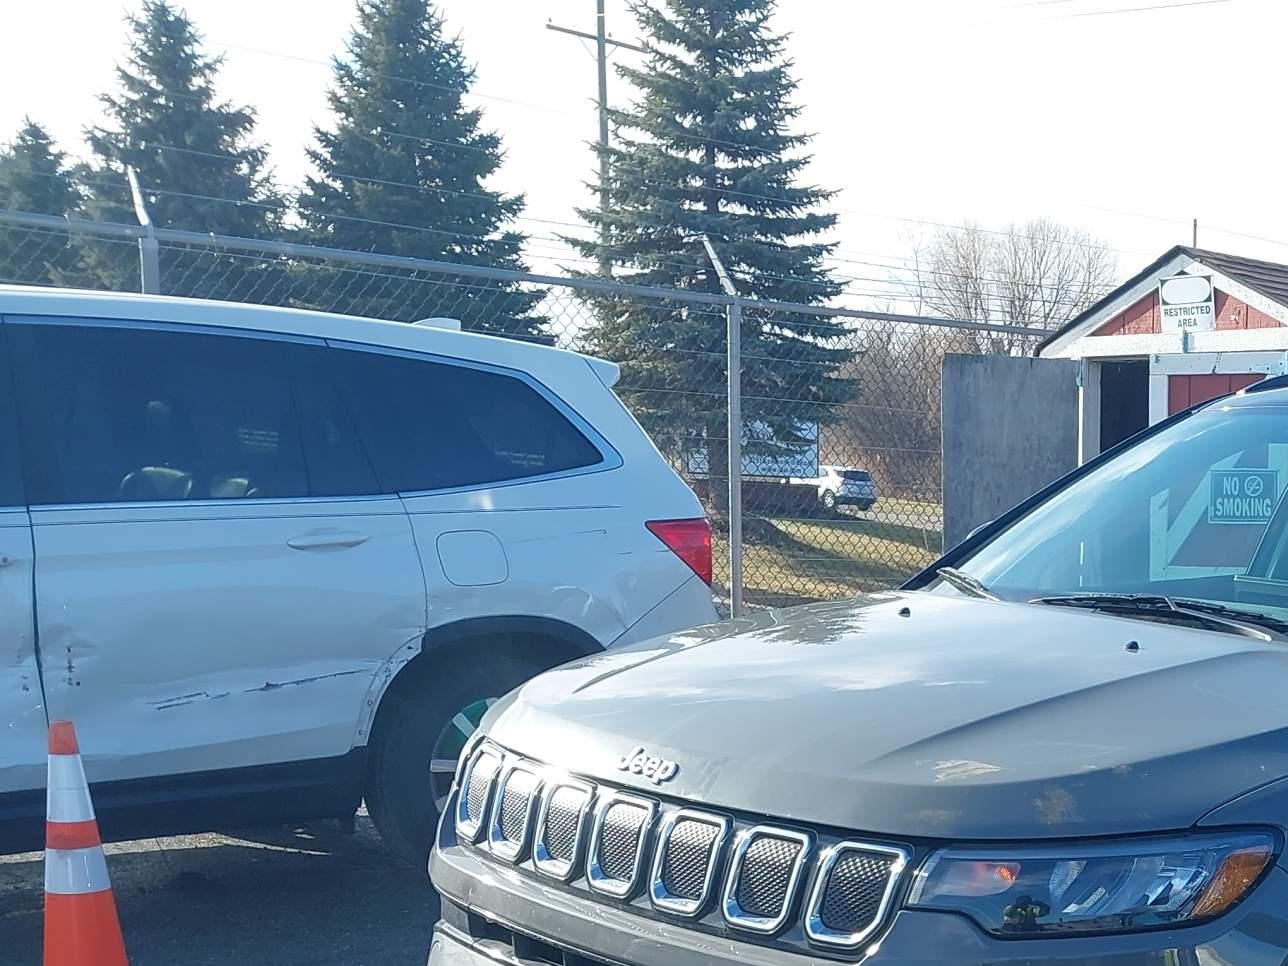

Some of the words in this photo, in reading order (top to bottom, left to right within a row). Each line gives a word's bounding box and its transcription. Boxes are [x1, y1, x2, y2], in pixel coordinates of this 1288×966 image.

[1163, 305, 1211, 318] RESTRICTED
[1177, 318, 1198, 329] AREA
[1223, 476, 1239, 496] NO
[1215, 498, 1272, 517] SMOKING
[617, 745, 680, 787] Jeep
